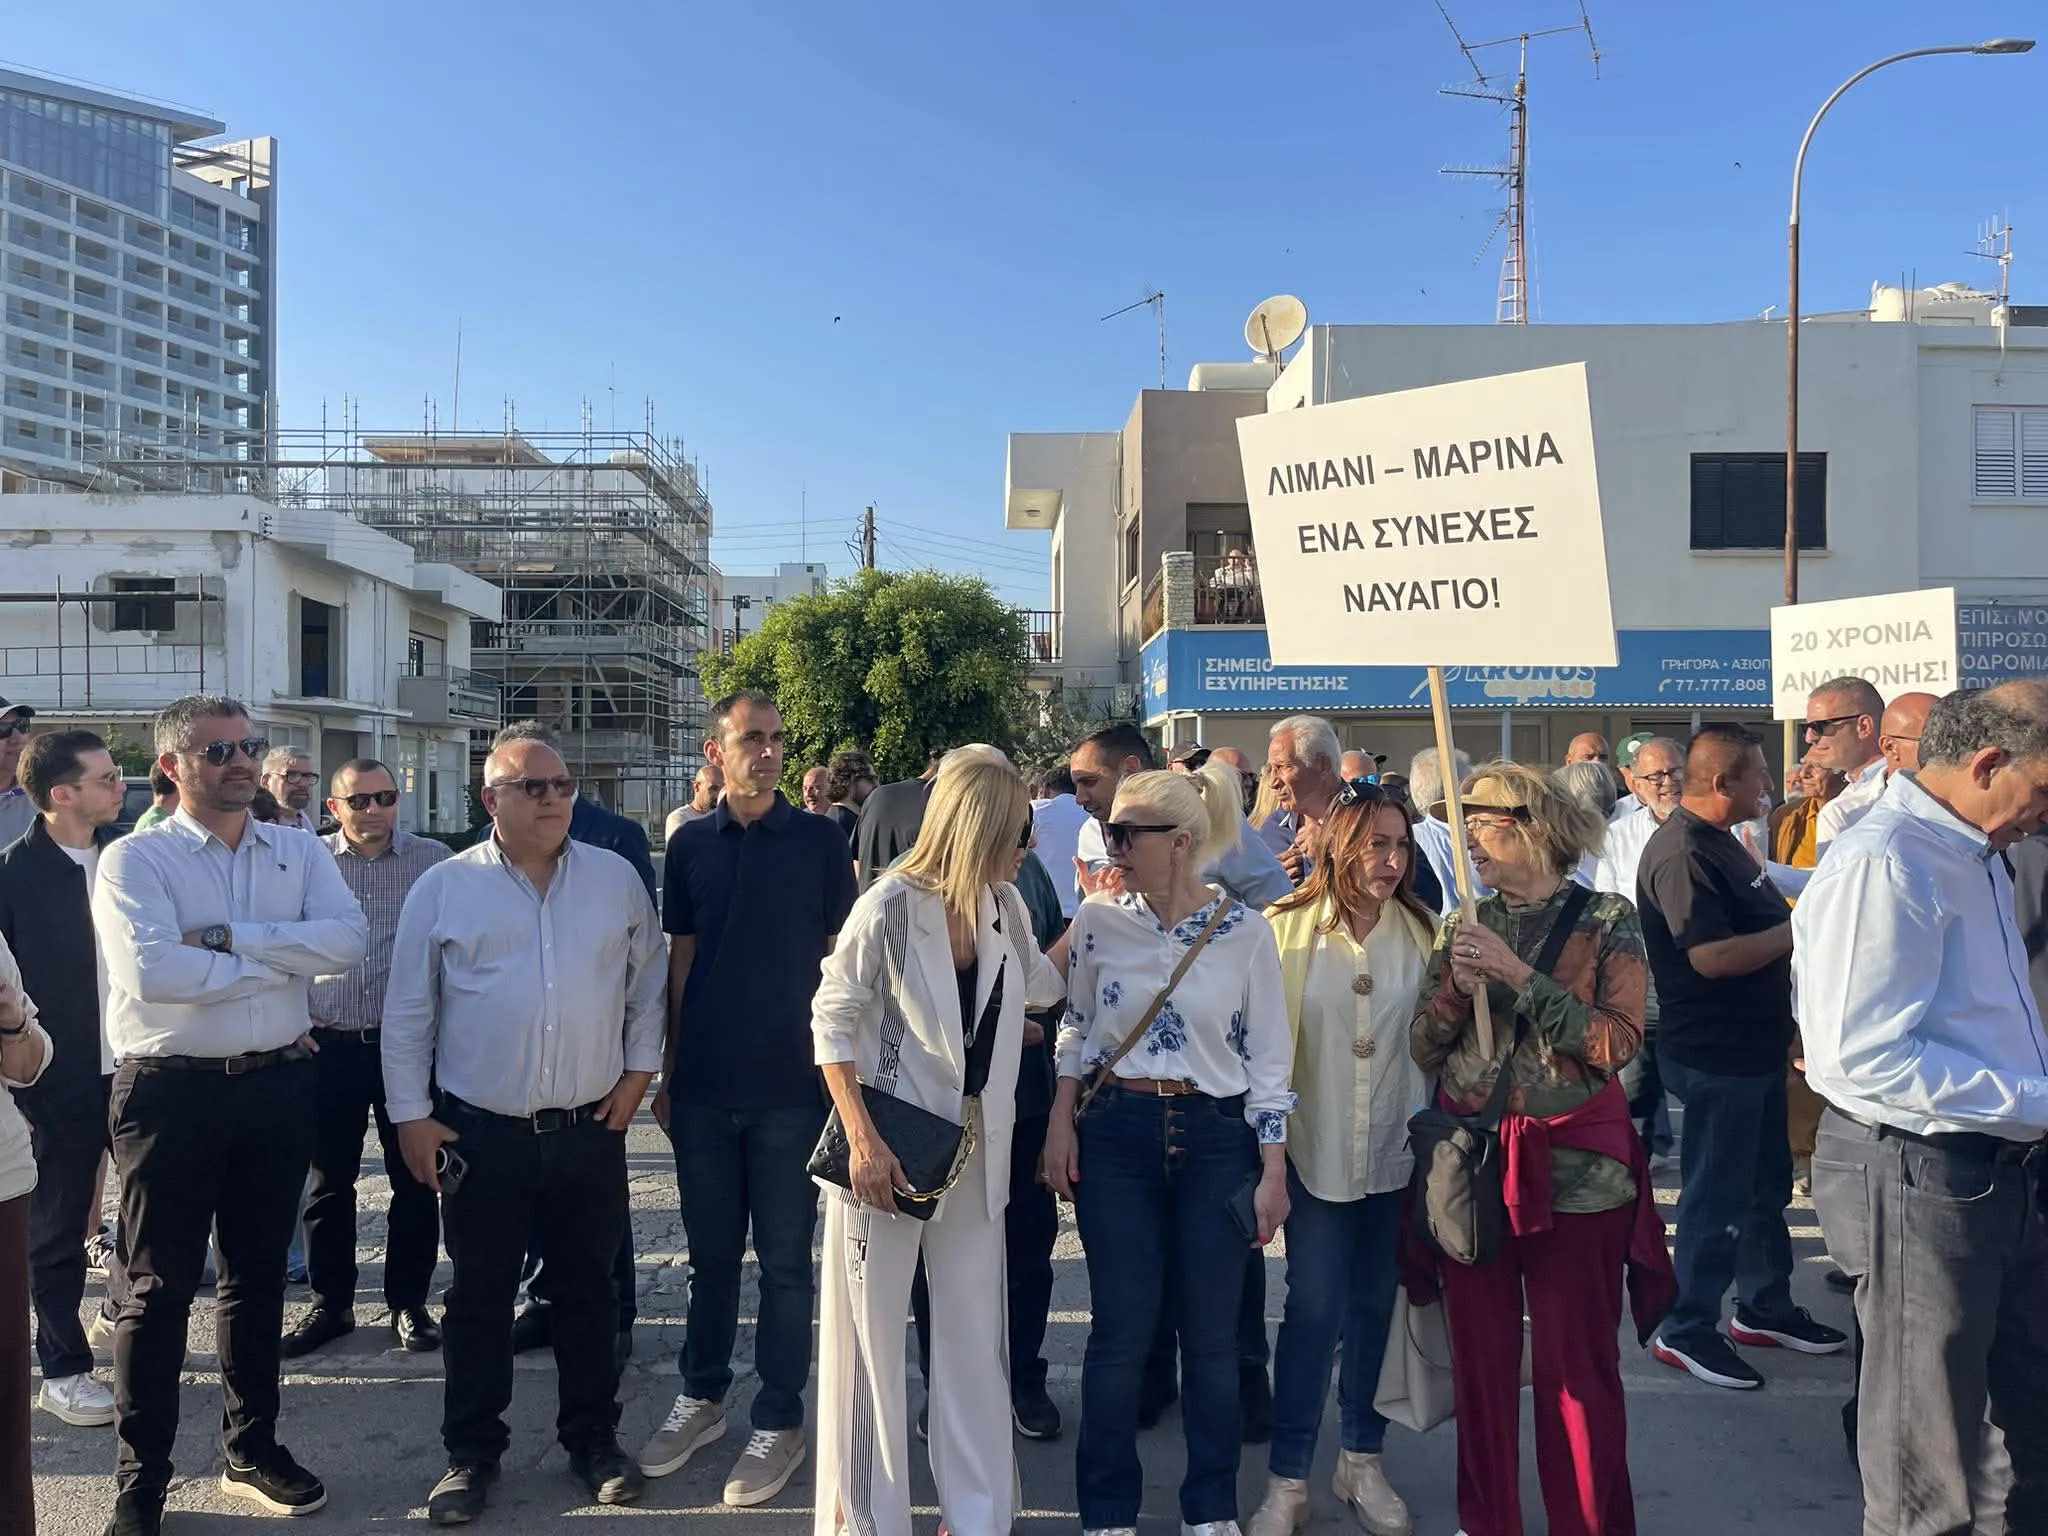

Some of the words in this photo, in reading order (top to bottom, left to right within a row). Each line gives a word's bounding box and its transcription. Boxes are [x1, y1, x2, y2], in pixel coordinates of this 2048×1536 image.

[1268, 454, 1375, 496] ΛΙΜΑΝΙ
[1413, 431, 1564, 480] ΜΑΡΙΝΑ
[1298, 521, 1365, 554] ΕΝΑ
[1372, 505, 1539, 549] ΣΥΝΕΧΕΣ
[1343, 577, 1501, 613] ΝΑΥΑΓΙΟ!
[1790, 631, 1818, 652] 20
[1826, 619, 1933, 650] ΧΡΟΝΙΑ
[1206, 658, 1274, 672] ΣΗΜΕΙΟ
[1662, 659, 1720, 670] ΓΡΗΓΟΡΑ
[1205, 676, 1349, 691] ΕΞΥΠΗΡΕΤΗΣΗΣ
[1675, 679, 1767, 691] 77.777.808
